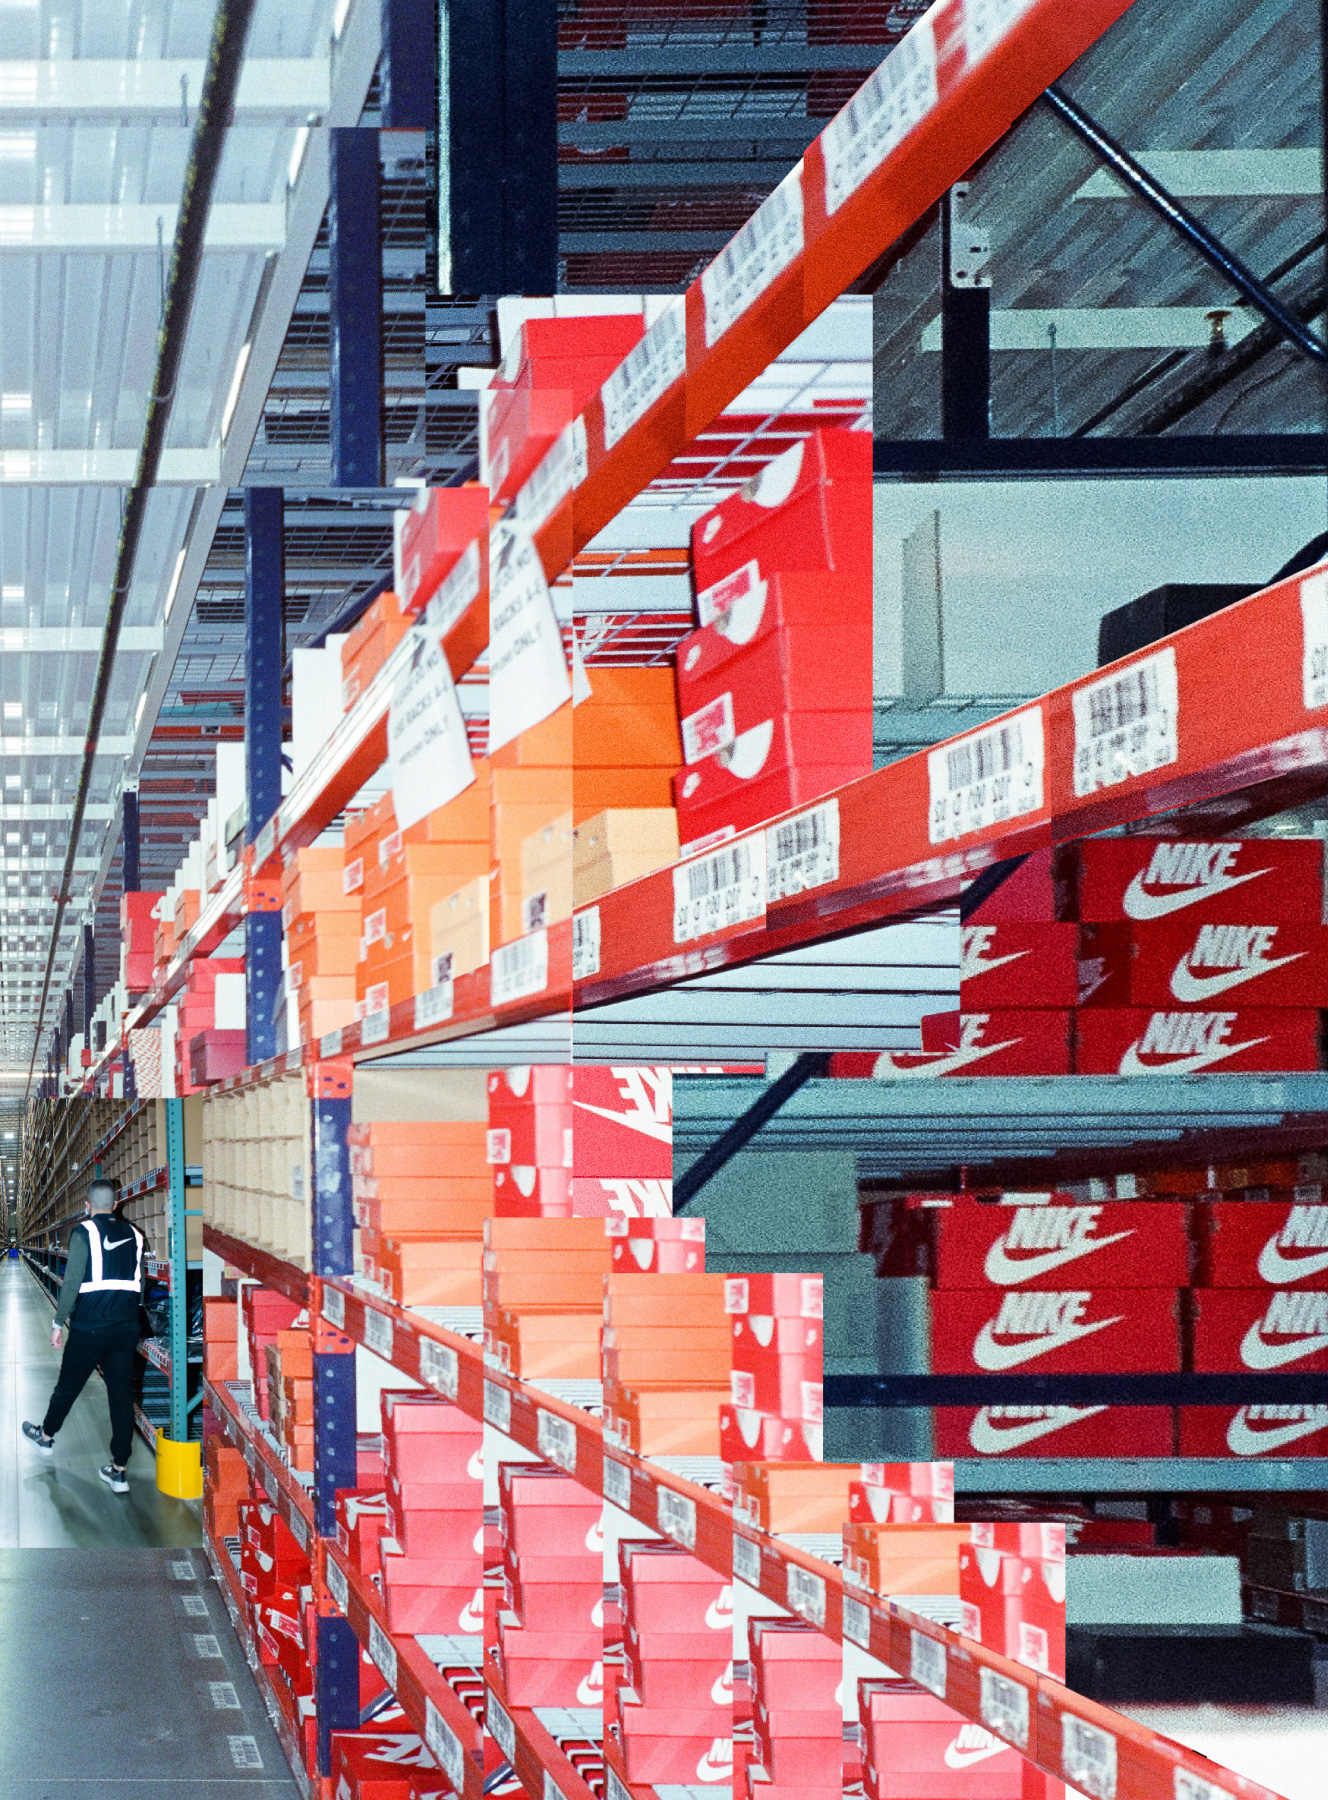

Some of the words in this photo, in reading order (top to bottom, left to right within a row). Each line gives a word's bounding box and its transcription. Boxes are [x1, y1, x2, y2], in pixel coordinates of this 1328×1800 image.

[1144, 843, 1242, 884] NIKE
[1190, 925, 1278, 968] NIKE
[1138, 1012, 1238, 1053] NIKE
[1006, 1206, 1103, 1249] NIKE
[994, 1291, 1092, 1334] NIKE
